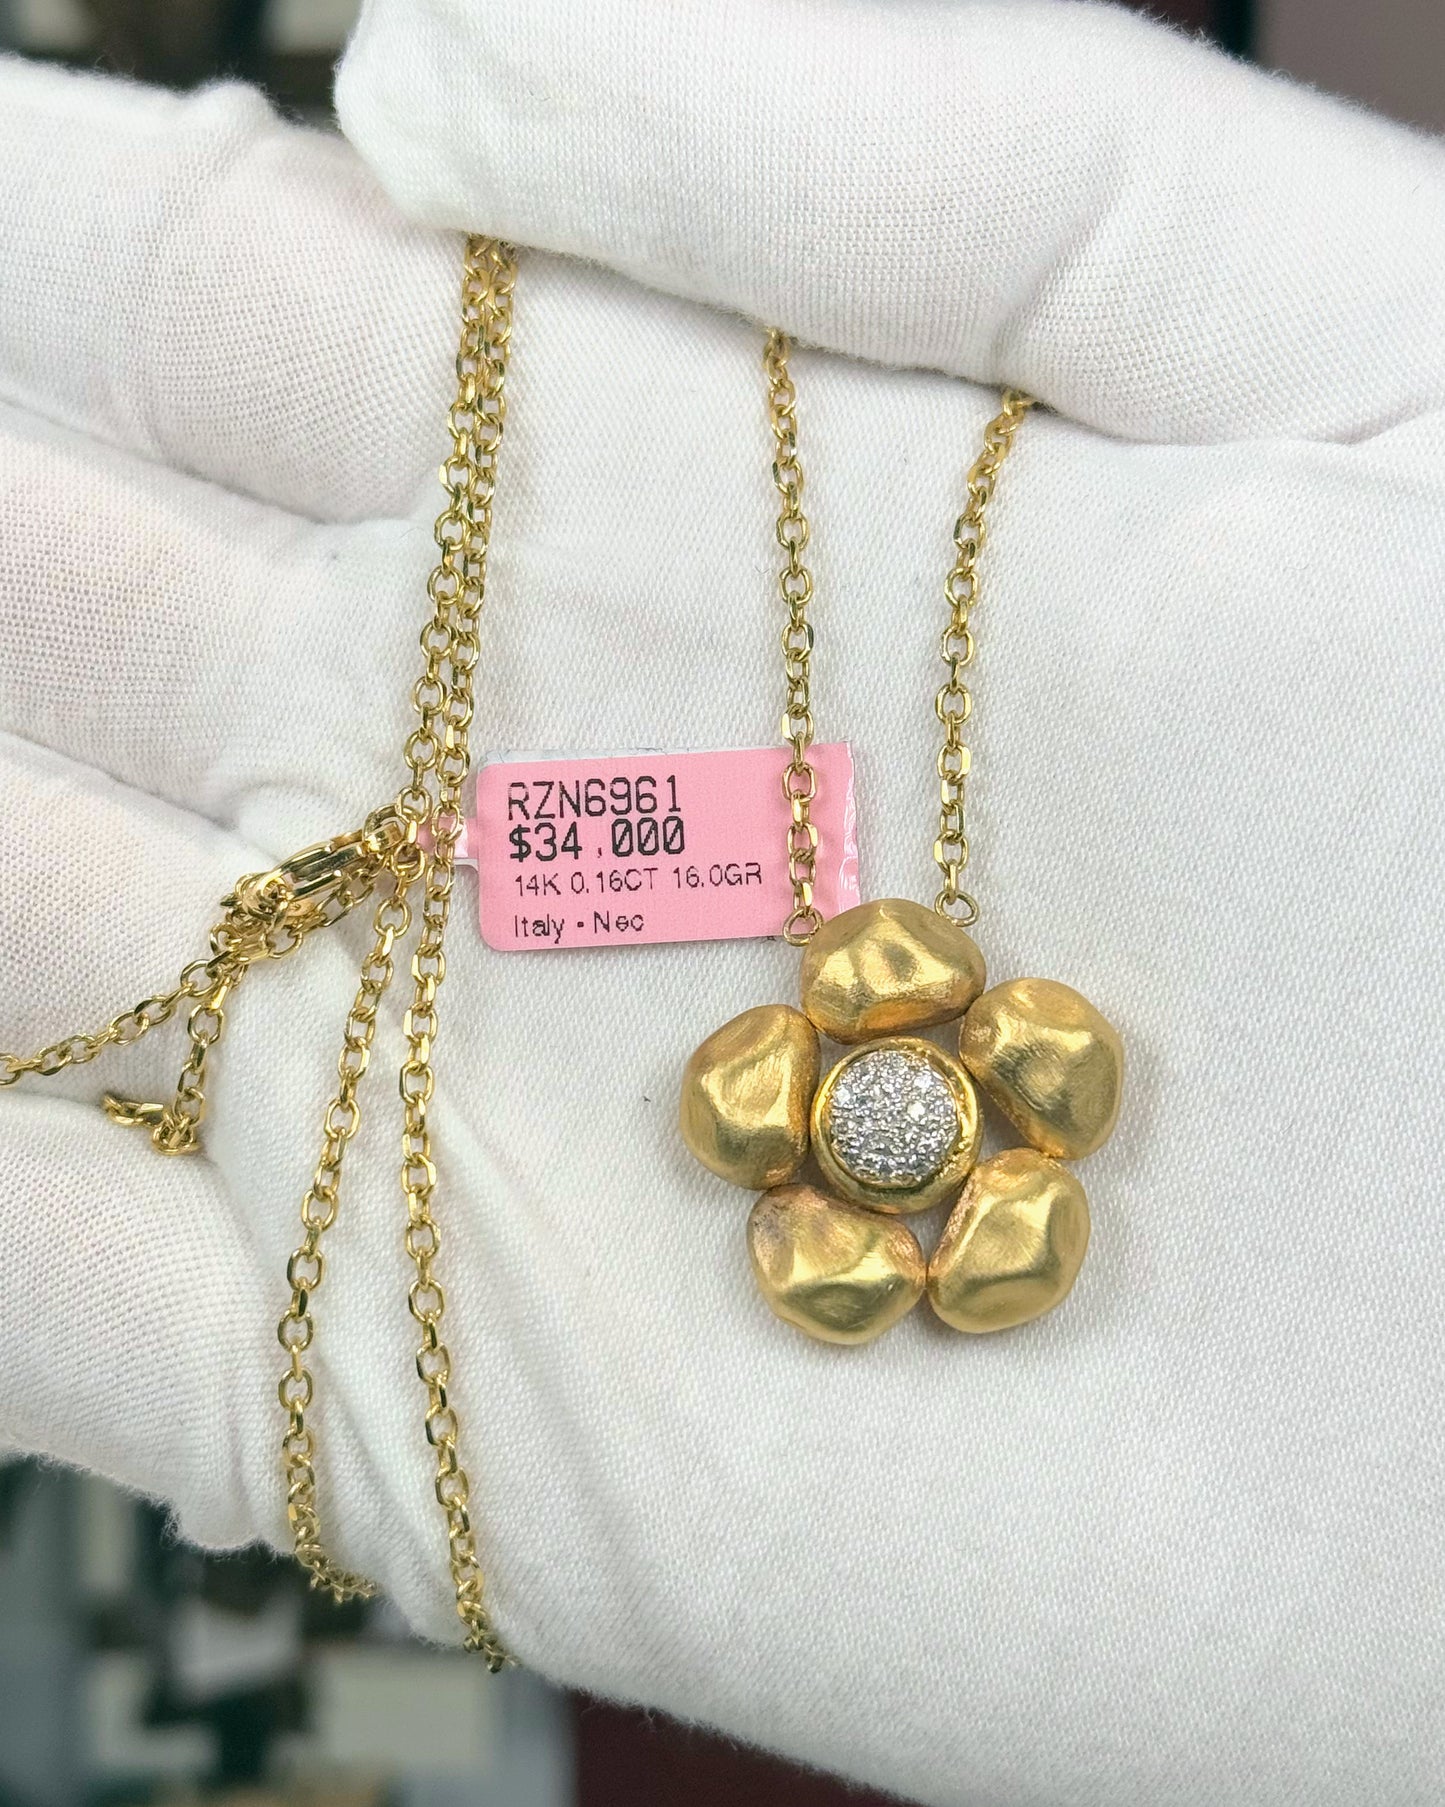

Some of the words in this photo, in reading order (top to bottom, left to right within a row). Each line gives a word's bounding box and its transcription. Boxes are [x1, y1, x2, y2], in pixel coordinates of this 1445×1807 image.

[508, 775, 682, 821] RZN6961
[515, 872, 561, 897] 14K
[570, 866, 659, 895] 0.16CT
[672, 862, 763, 889] 16.0GR
[513, 913, 565, 945] Italy
[593, 911, 645, 935] Nec
